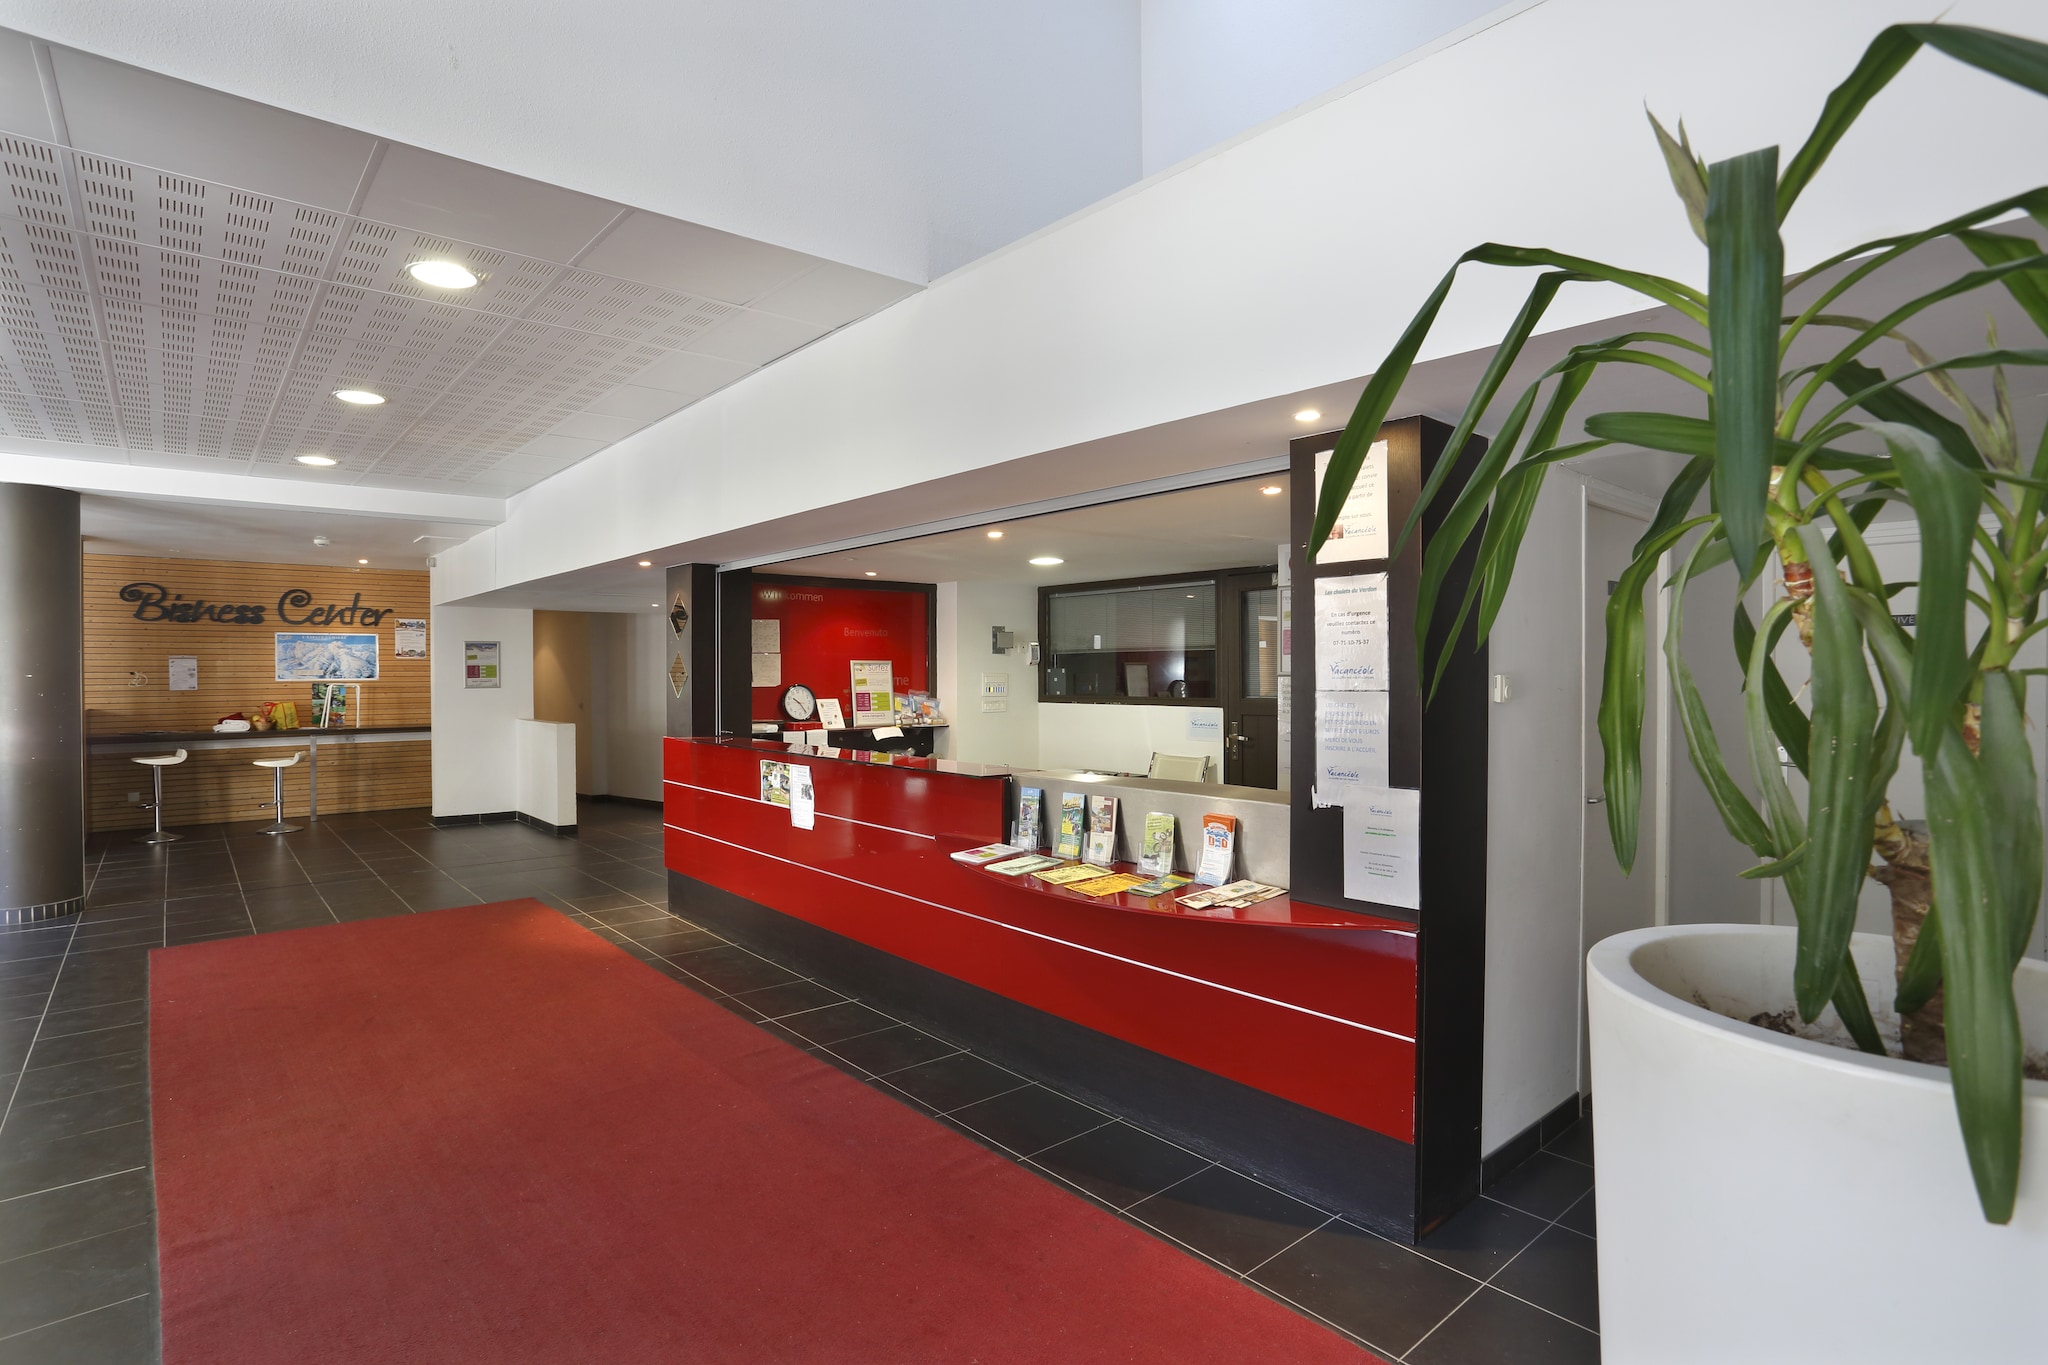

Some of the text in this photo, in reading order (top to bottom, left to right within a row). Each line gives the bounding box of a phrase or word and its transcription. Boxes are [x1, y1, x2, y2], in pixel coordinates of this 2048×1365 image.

[119, 582, 394, 627] Bisness Center
[1329, 663, 1375, 676] Vacancéole
